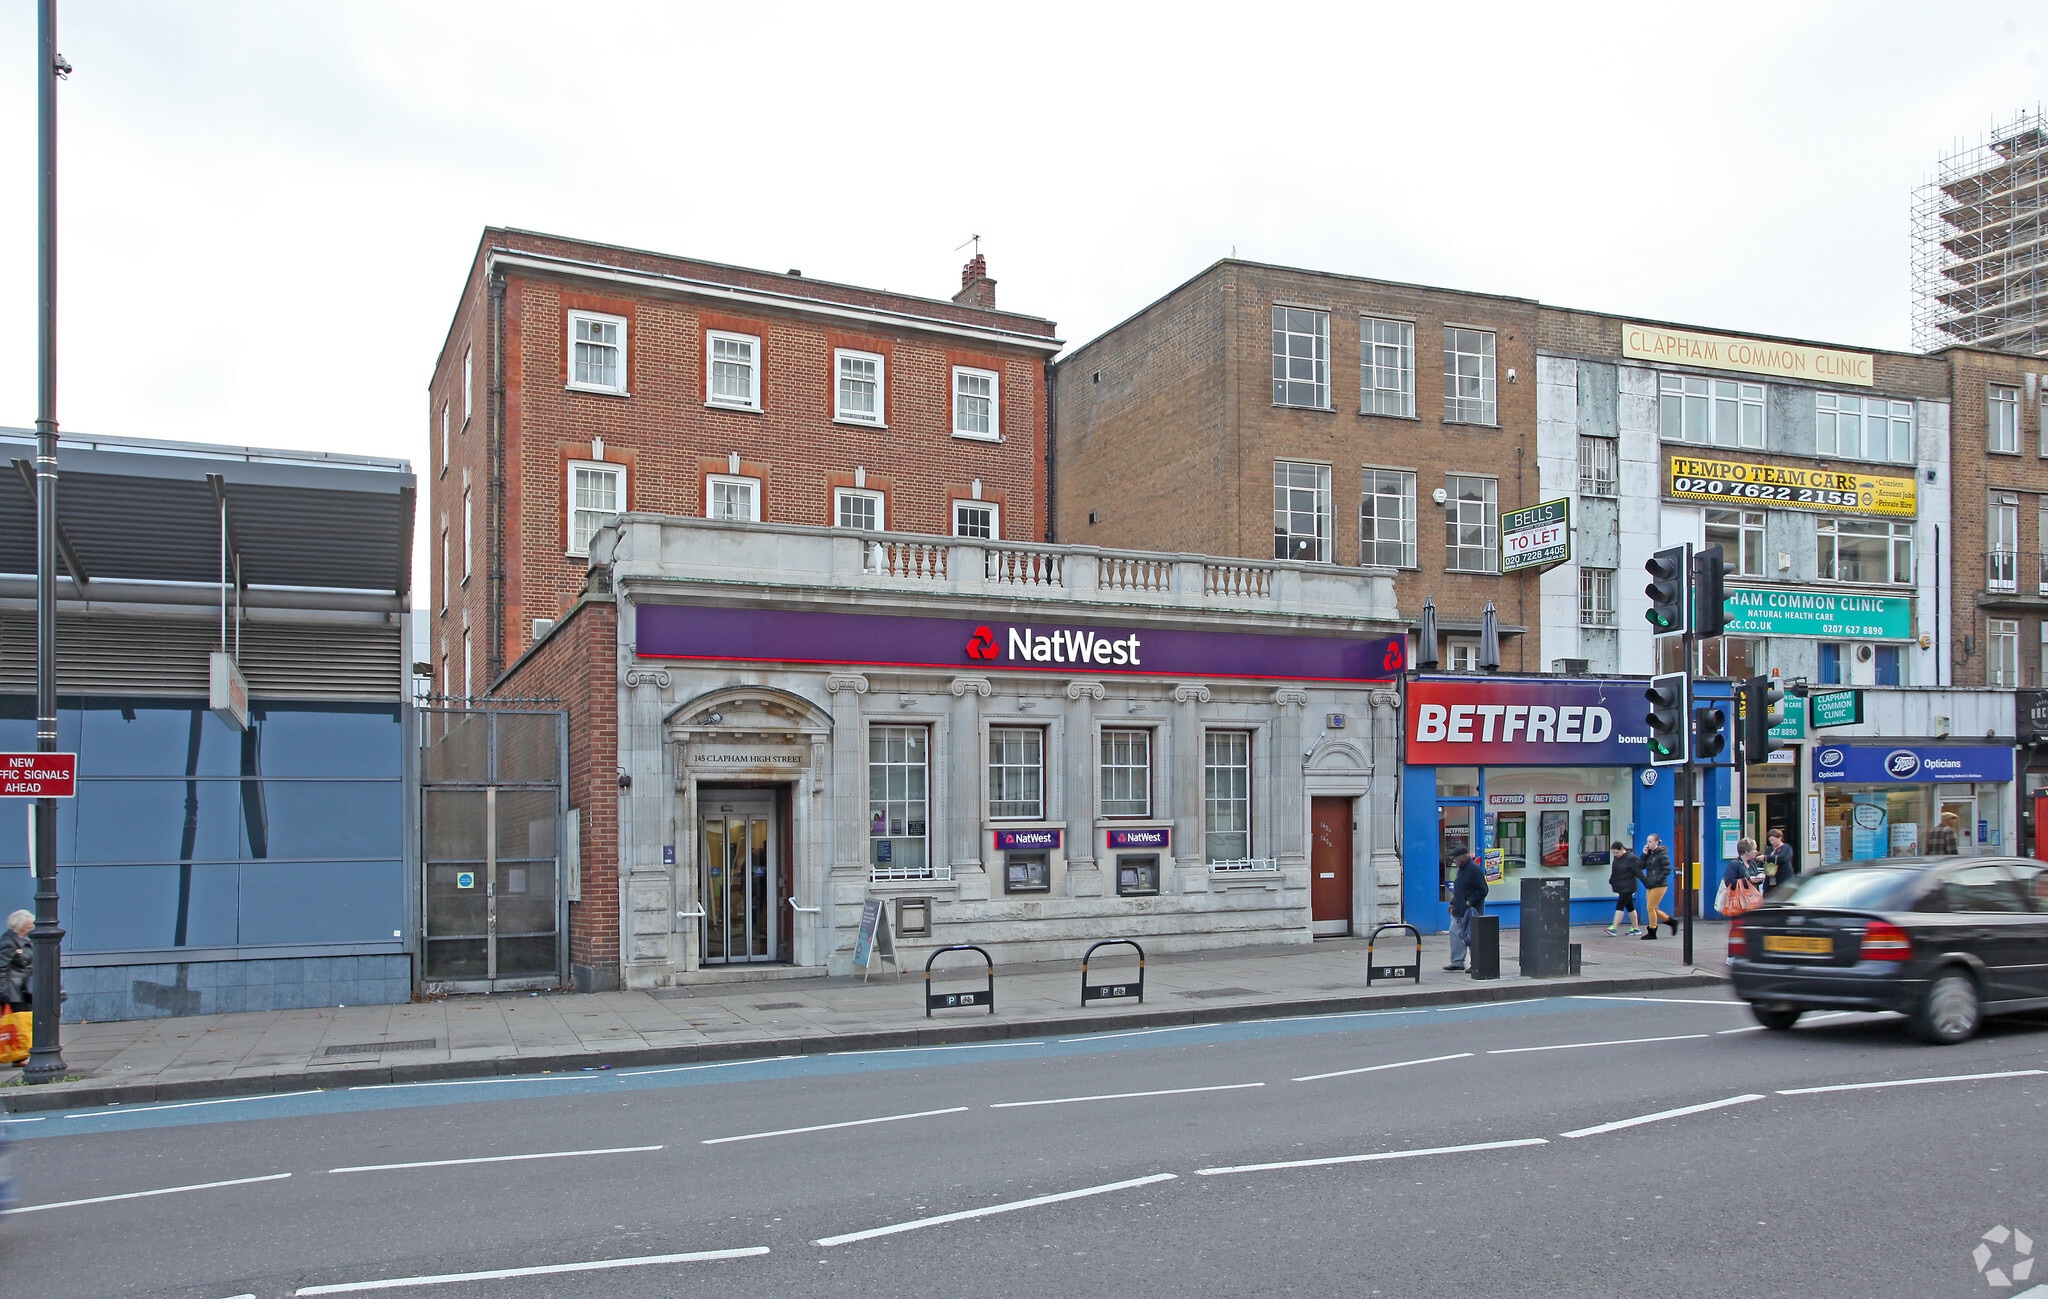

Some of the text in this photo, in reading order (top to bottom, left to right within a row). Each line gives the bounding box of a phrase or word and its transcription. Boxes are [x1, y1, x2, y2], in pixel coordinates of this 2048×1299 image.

[1629, 331, 1867, 379] CLAPHAM COMMON CLINIC
[1675, 459, 1857, 491] TEMPO TEAM CARS
[1879, 479, 1904, 488] Couriers
[1675, 478, 1857, 506] 020 7622 2155
[1878, 490, 1915, 499] Account Jobs
[1878, 500, 1899, 508] Private
[1514, 506, 1553, 527] BELLS
[1510, 536, 1529, 551] TO
[1533, 528, 1559, 546] LET
[1505, 555, 1520, 566] 020
[1522, 550, 1542, 562] 7228
[1544, 545, 1565, 557] 4405
[1769, 593, 1835, 610] COMMON
[1840, 597, 1884, 613] CLINIC
[1748, 609, 1834, 621] NATURAL HEALTH CARE
[1823, 624, 1883, 635] 0207 627 8890
[1008, 627, 1141, 666] NatWest
[1818, 691, 1852, 703] CLAPHAM
[1817, 700, 1852, 711] COMMON
[1824, 709, 1846, 719] CLINIC
[1416, 703, 1612, 743] BETFRED
[1618, 734, 1648, 744] bonus
[9, 758, 35, 768] NEW
[707, 755, 748, 763] CLAPHAM
[1924, 758, 1961, 770] Opticians
[24, 770, 70, 780] SIGNALS
[1819, 771, 1845, 779] Opticians
[5, 783, 42, 793] AHEAD
[1535, 794, 1567, 802] BETFRED
[1577, 794, 1608, 802] BETFRED
[1016, 833, 1052, 844] NatWest
[1127, 832, 1161, 843] NatWest
